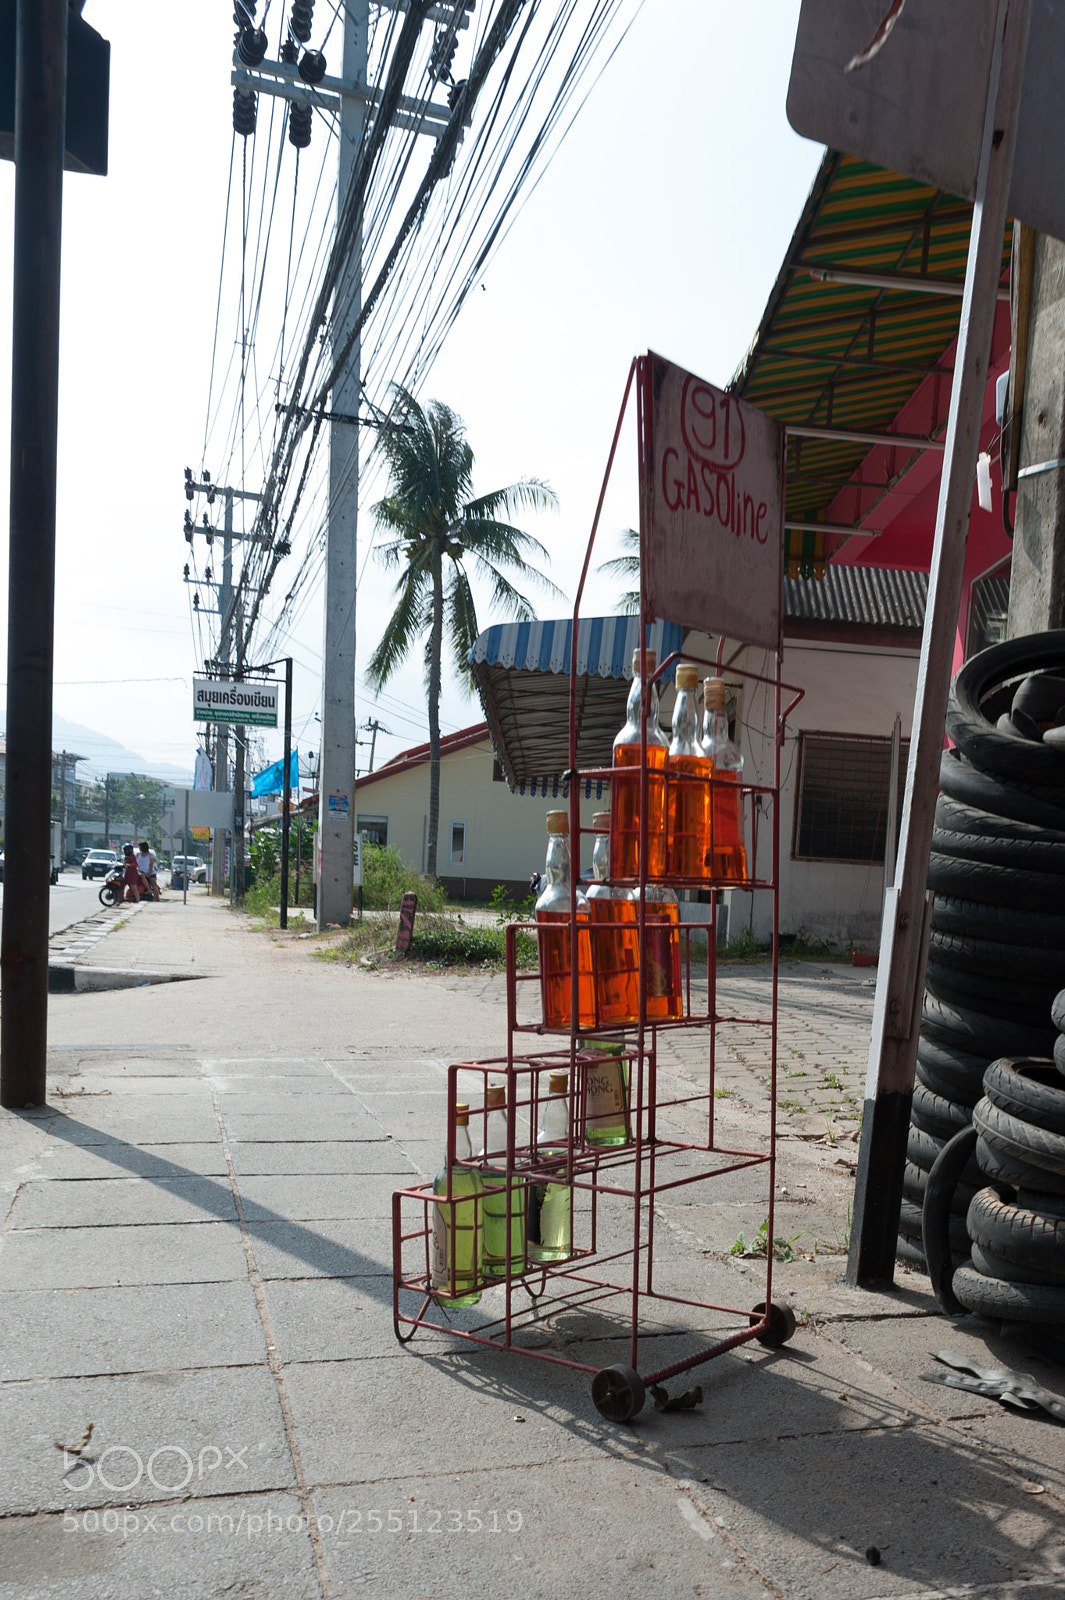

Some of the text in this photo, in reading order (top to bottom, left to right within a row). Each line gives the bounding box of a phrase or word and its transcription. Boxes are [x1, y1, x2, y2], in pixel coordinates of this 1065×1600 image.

[691, 385, 731, 460] 91
[196, 685, 276, 709] สมุยเครื่องเขียน
[587, 1075, 609, 1086] ONG
